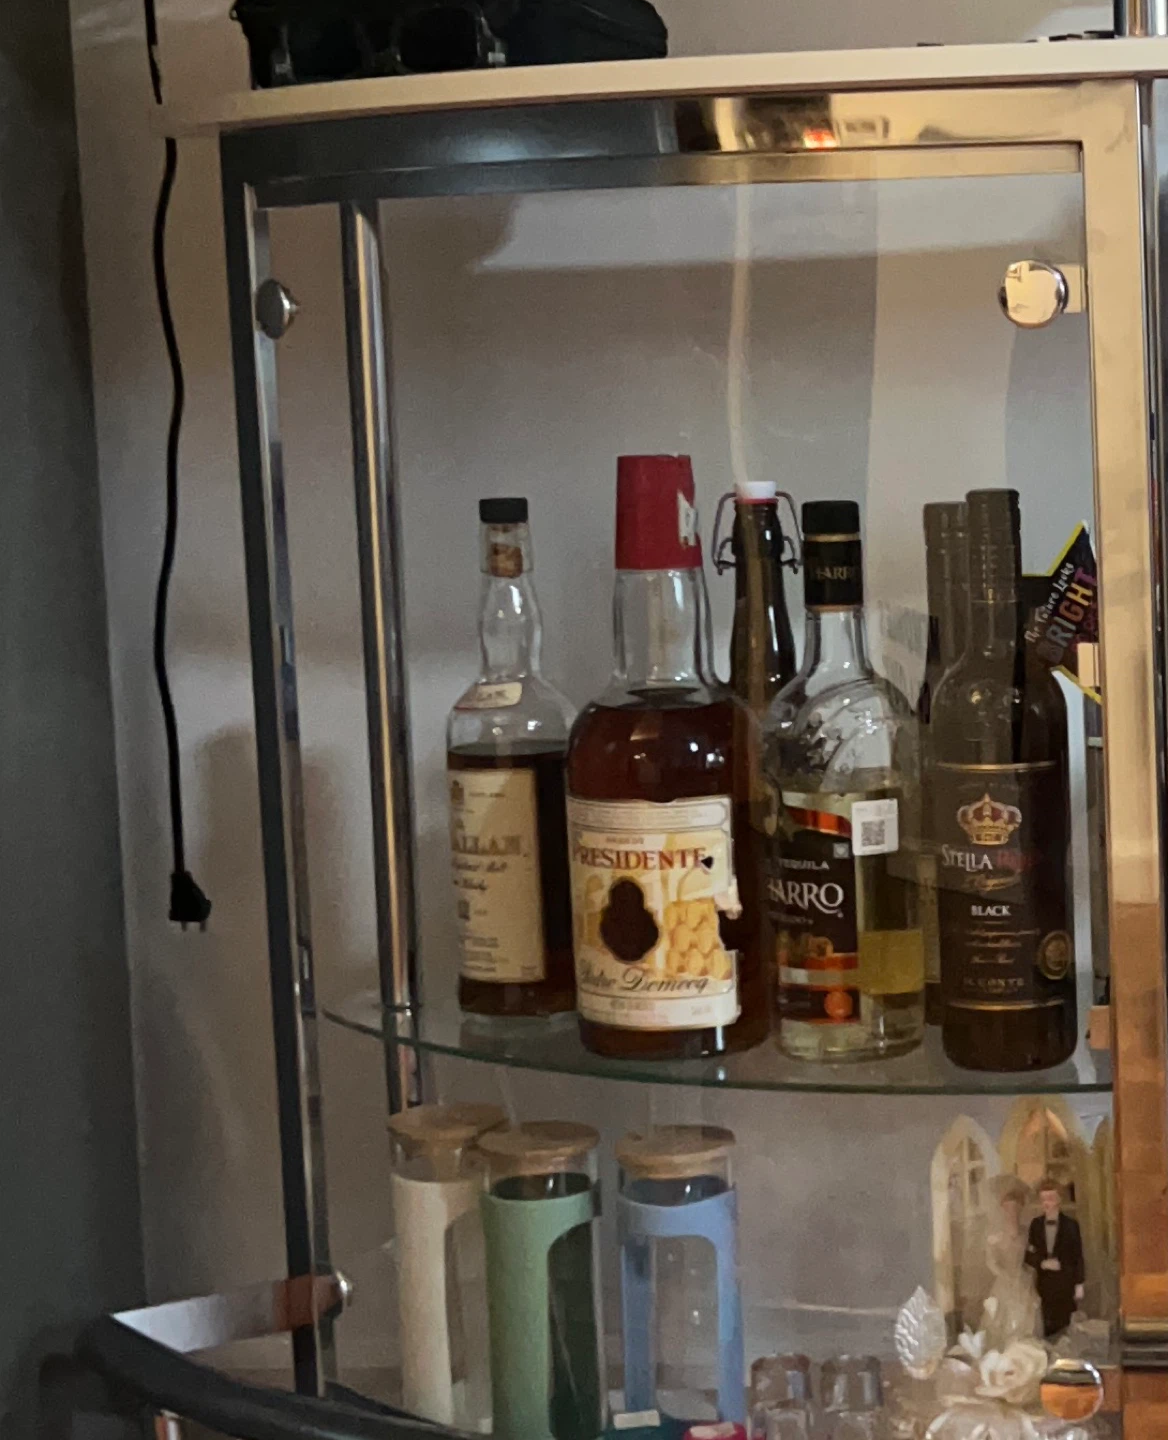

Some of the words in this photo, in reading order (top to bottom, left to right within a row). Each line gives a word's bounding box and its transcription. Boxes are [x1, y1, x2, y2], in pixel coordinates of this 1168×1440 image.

[573, 844, 707, 871] PRESIDENTE
[940, 843, 994, 873] STELLA
[970, 904, 1012, 917] BLACK
